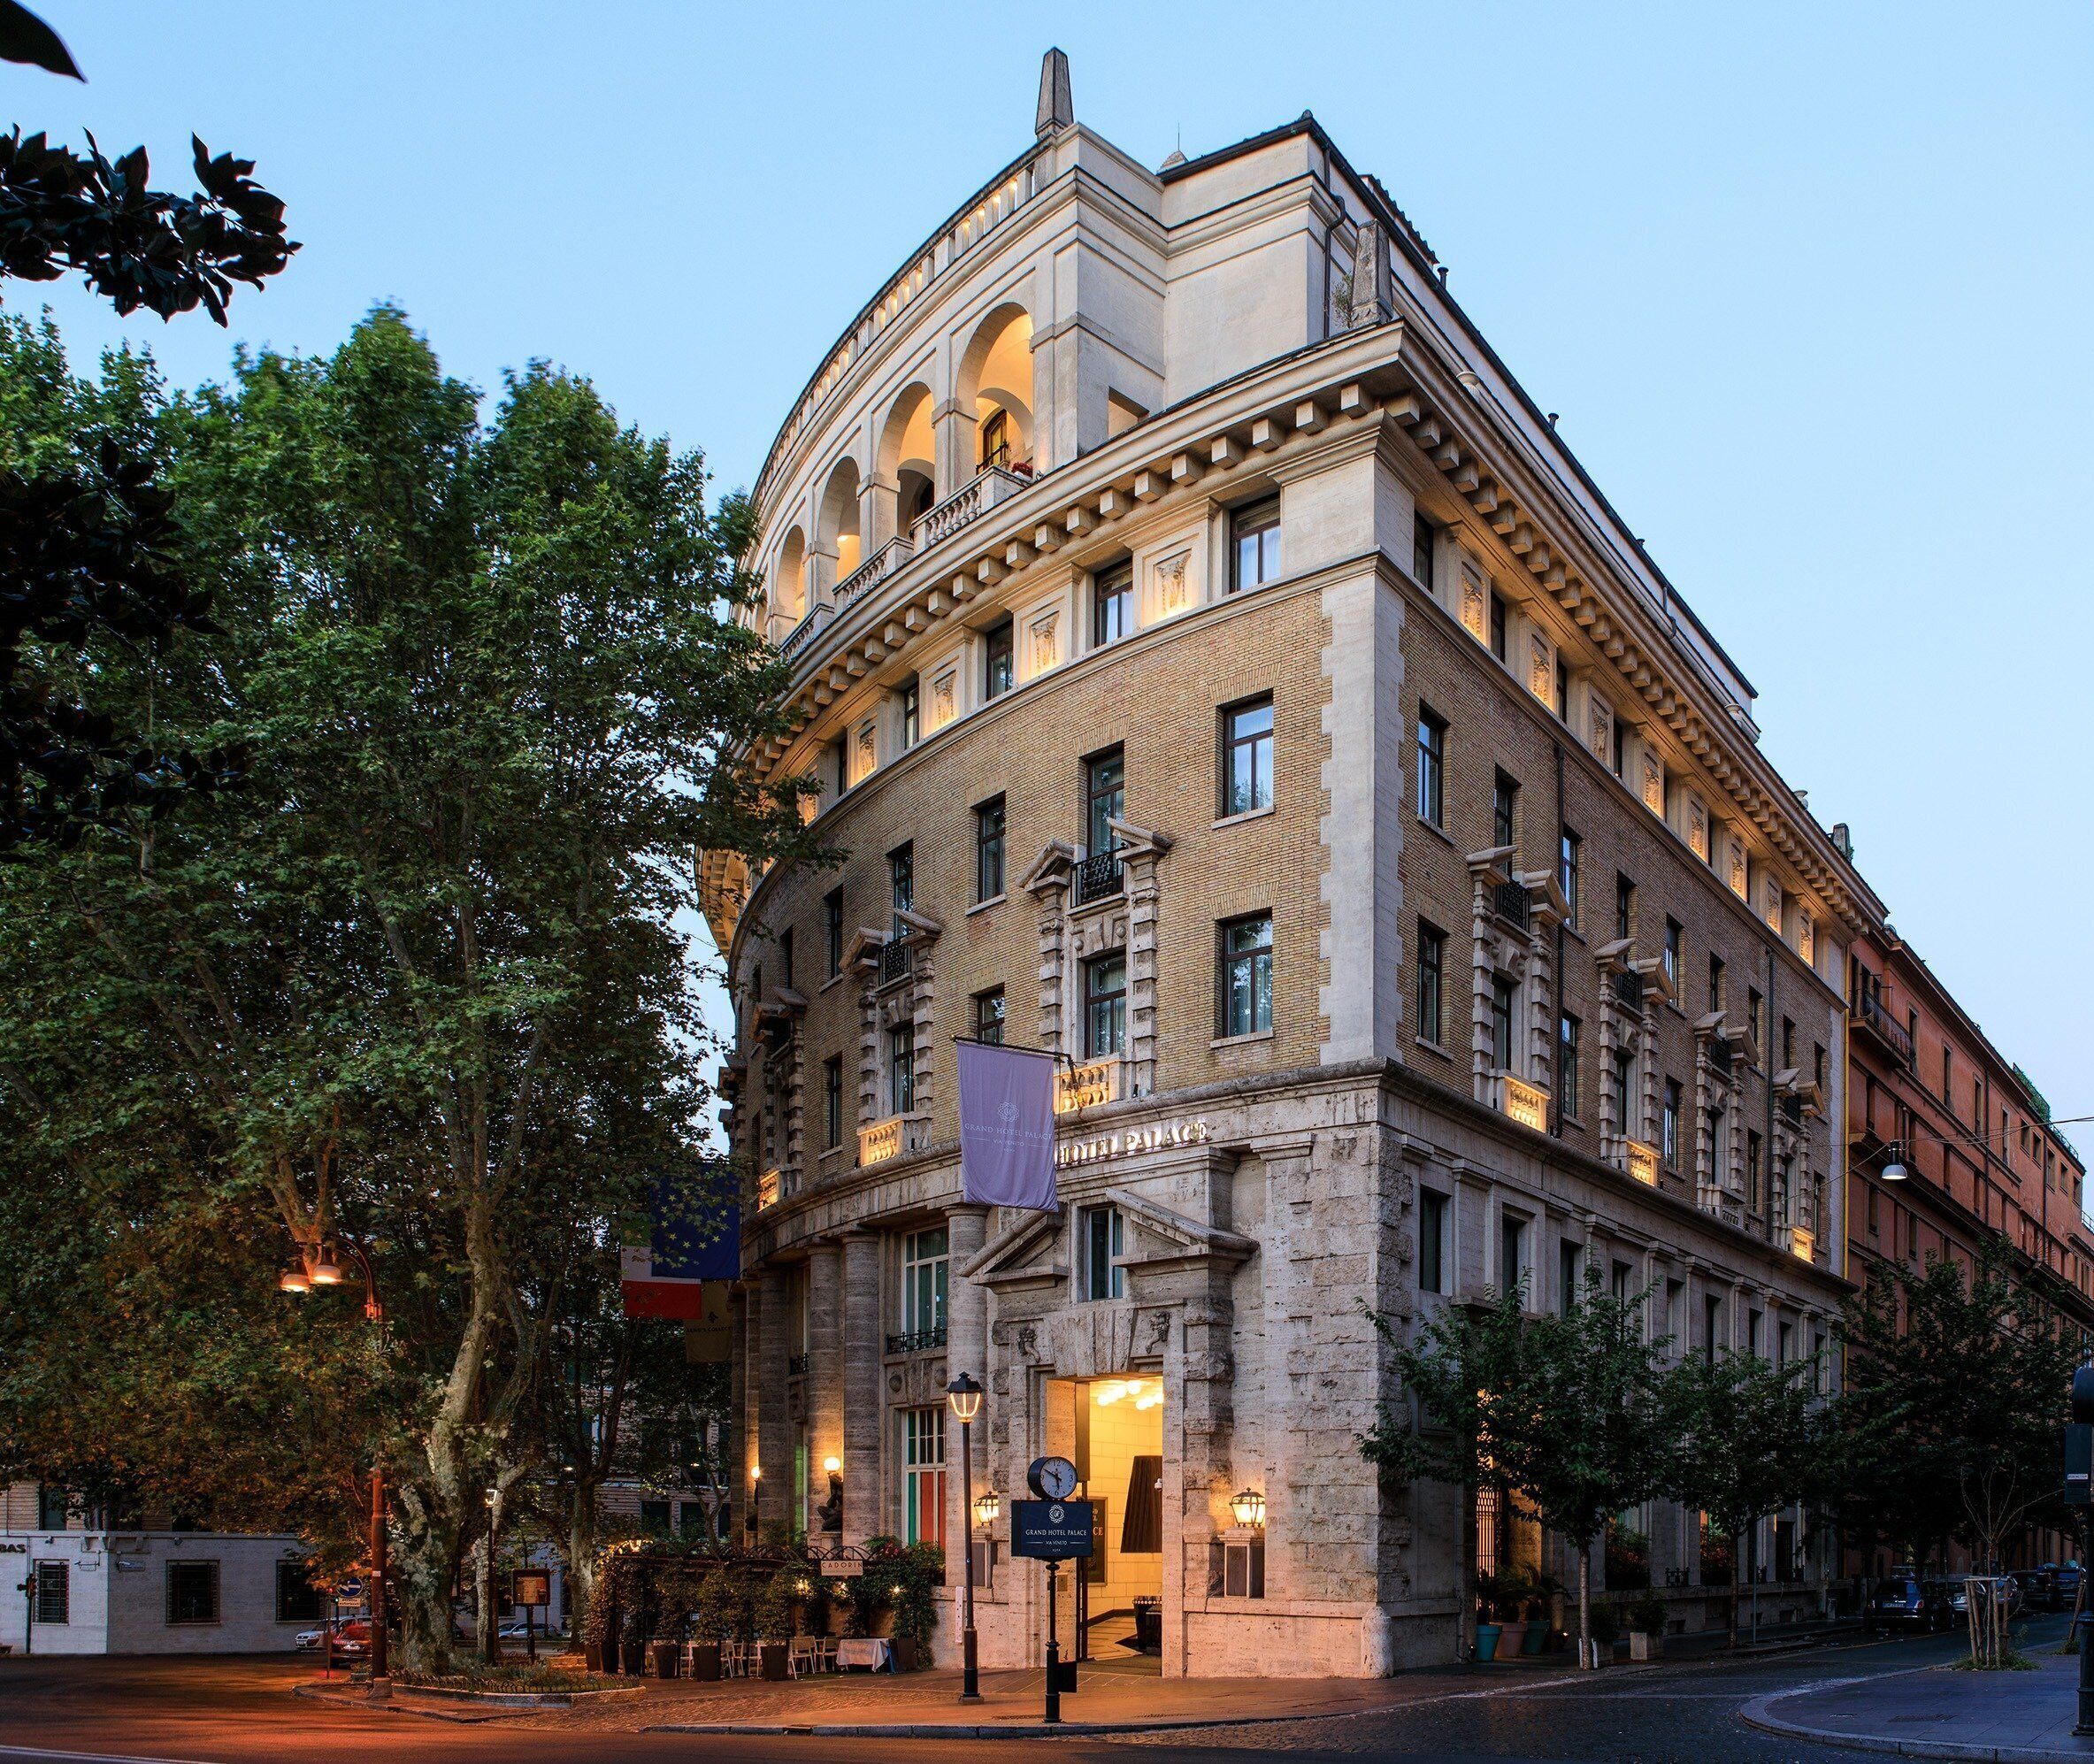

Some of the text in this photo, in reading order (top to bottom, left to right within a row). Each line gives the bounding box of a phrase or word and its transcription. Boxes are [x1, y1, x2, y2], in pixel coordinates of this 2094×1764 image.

[964, 1123, 993, 1133] GRAND
[996, 1127, 1023, 1137] HOTEL
[1055, 1123, 1209, 1163] HOTEL PALACE
[1069, 1474, 1074, 1483] 3
